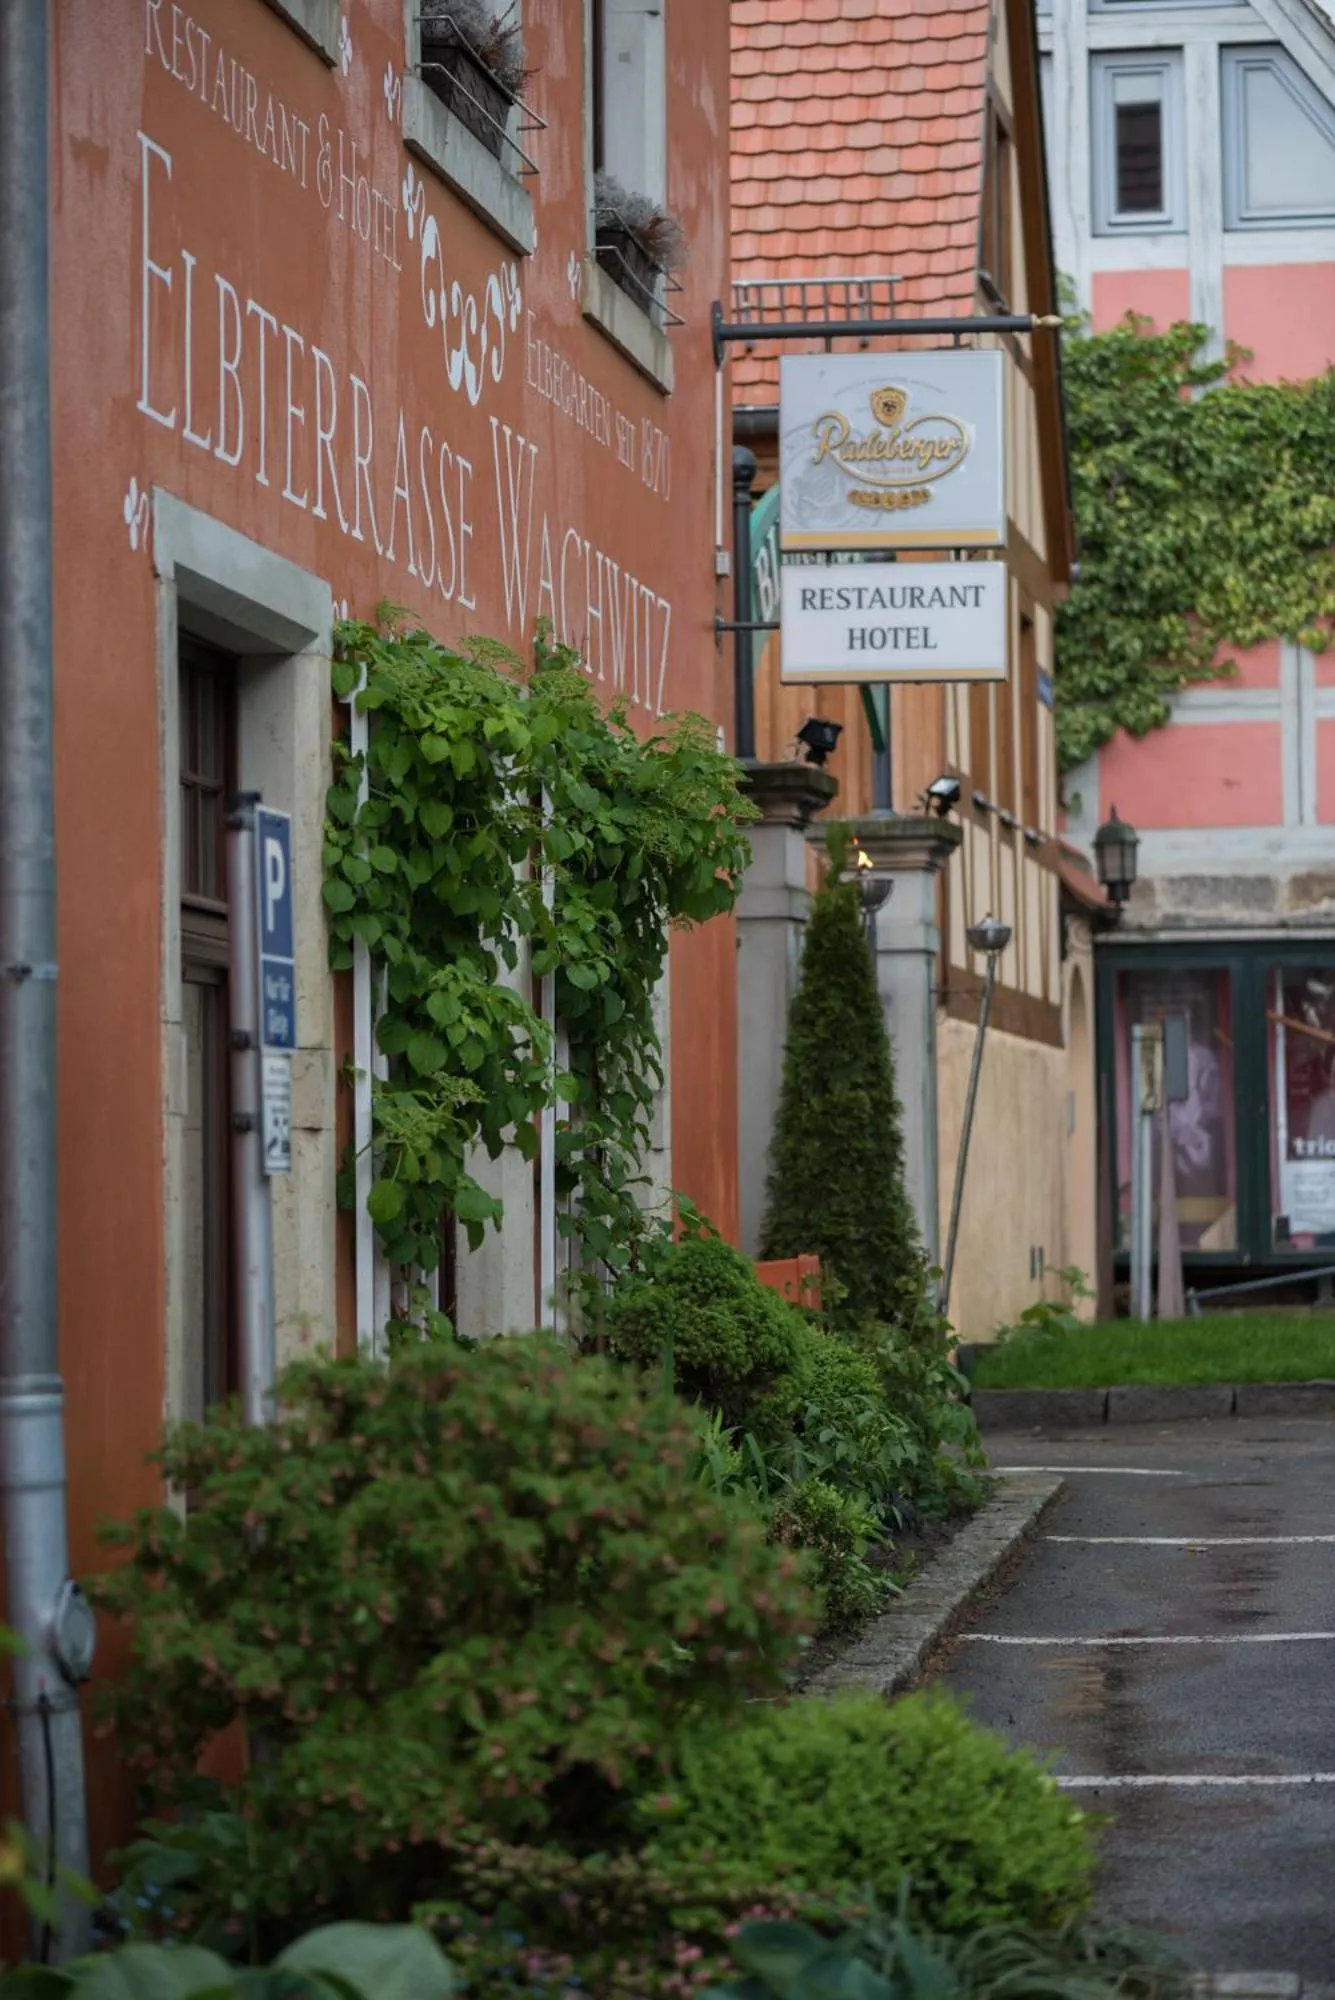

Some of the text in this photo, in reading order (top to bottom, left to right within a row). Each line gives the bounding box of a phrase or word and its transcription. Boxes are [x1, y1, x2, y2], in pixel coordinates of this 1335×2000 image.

[145, 0, 402, 272] RESTAURANT & HOTEL
[137, 130, 476, 611] ELBTERRASSE
[527, 309, 611, 447] ELBEGARTEN
[811, 409, 969, 478] Radeberger
[799, 585, 986, 611] RESTAURANT
[847, 625, 938, 651] HOTEL
[265, 836, 287, 933] P
